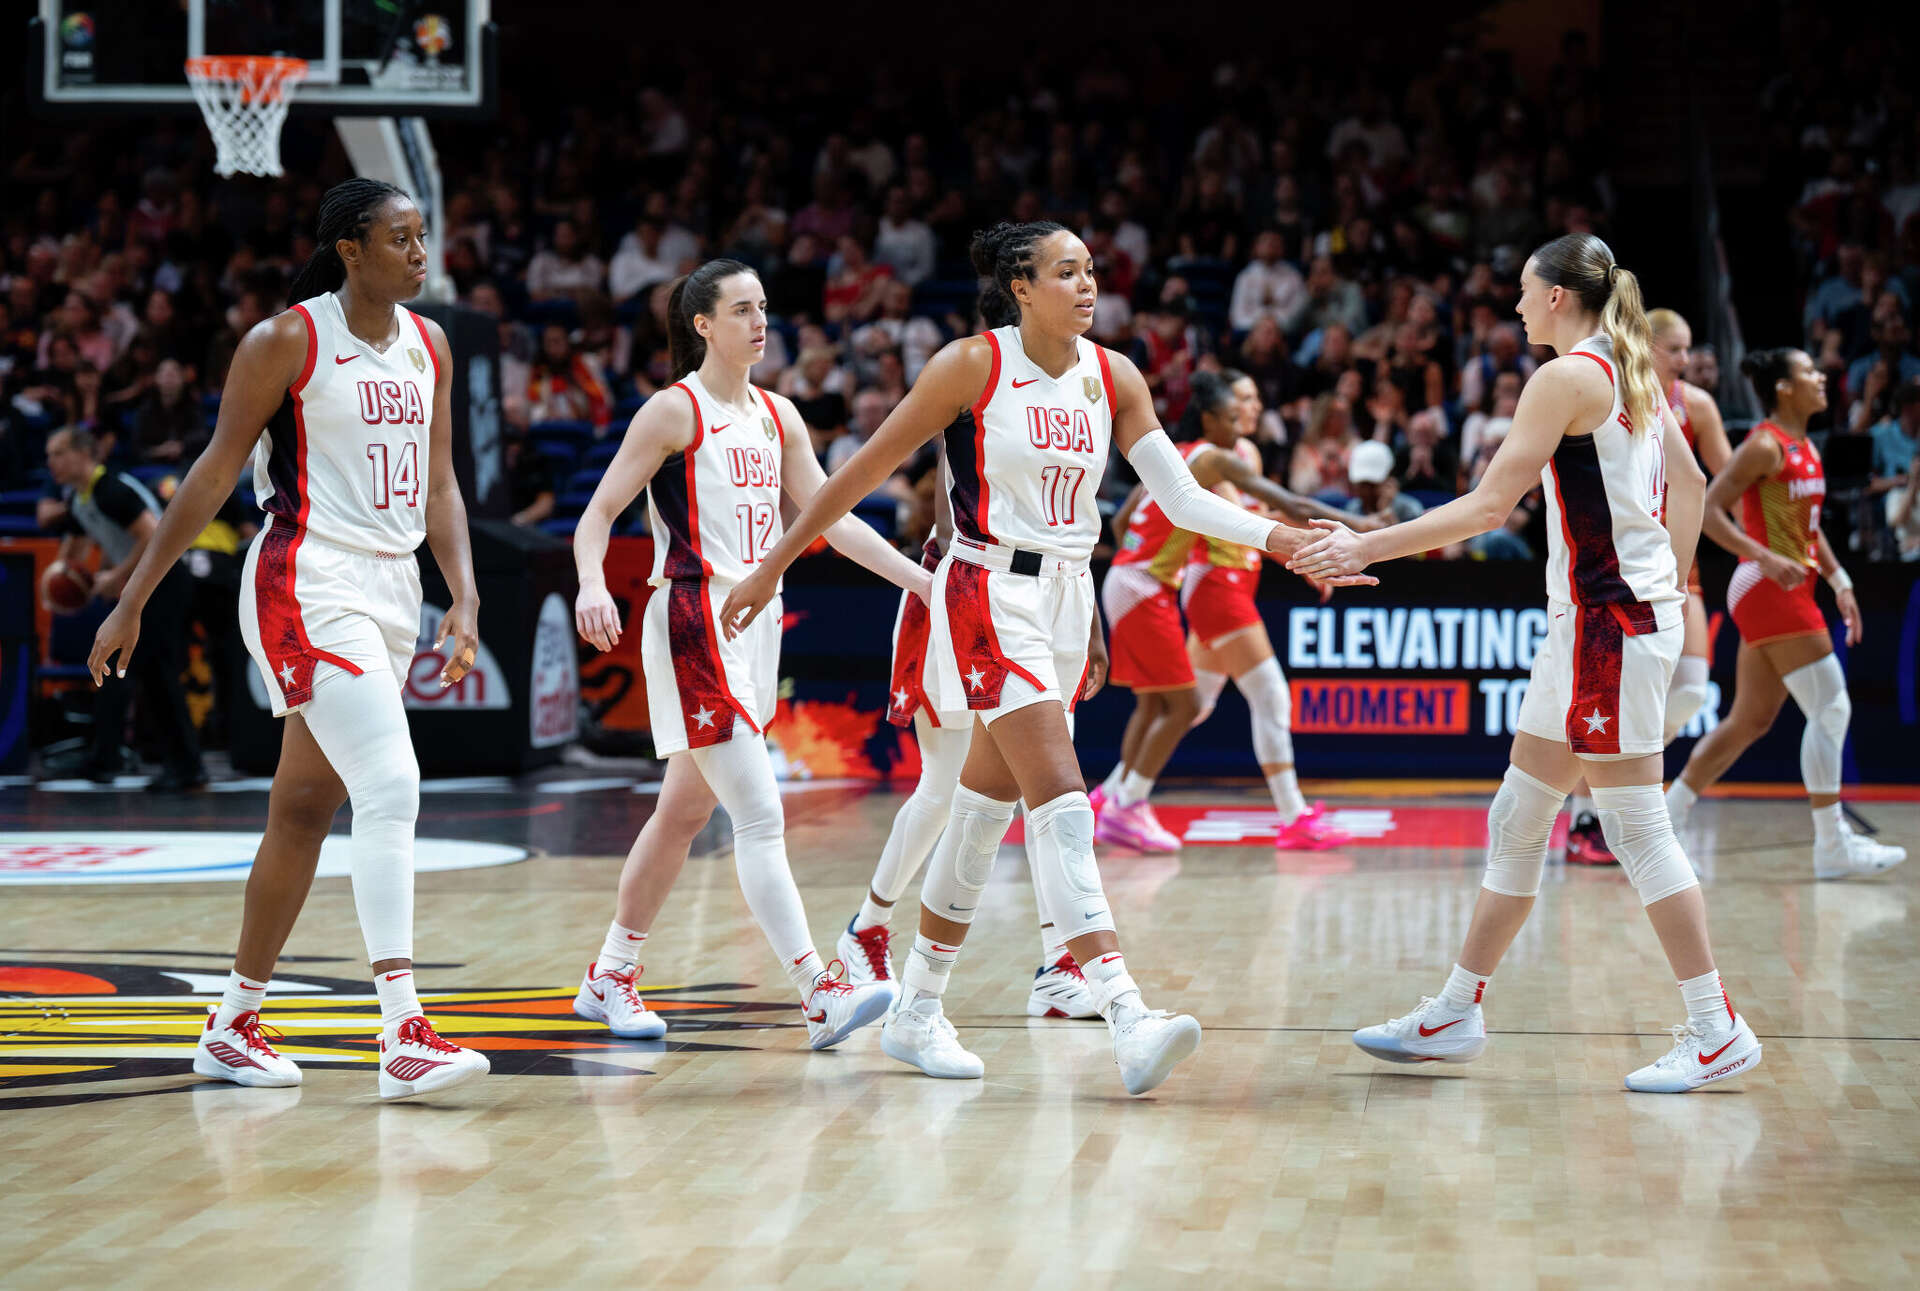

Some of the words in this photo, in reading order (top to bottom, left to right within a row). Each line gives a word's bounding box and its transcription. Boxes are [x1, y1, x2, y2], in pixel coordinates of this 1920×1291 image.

[357, 380, 424, 425] USA
[1026, 406, 1094, 453] USA
[367, 441, 419, 509] 14
[726, 447, 778, 488] USA
[1041, 465, 1085, 526] 11
[736, 502, 774, 564] 12
[1288, 607, 1548, 670] ELEVATING
[1300, 687, 1456, 726] MOMENT
